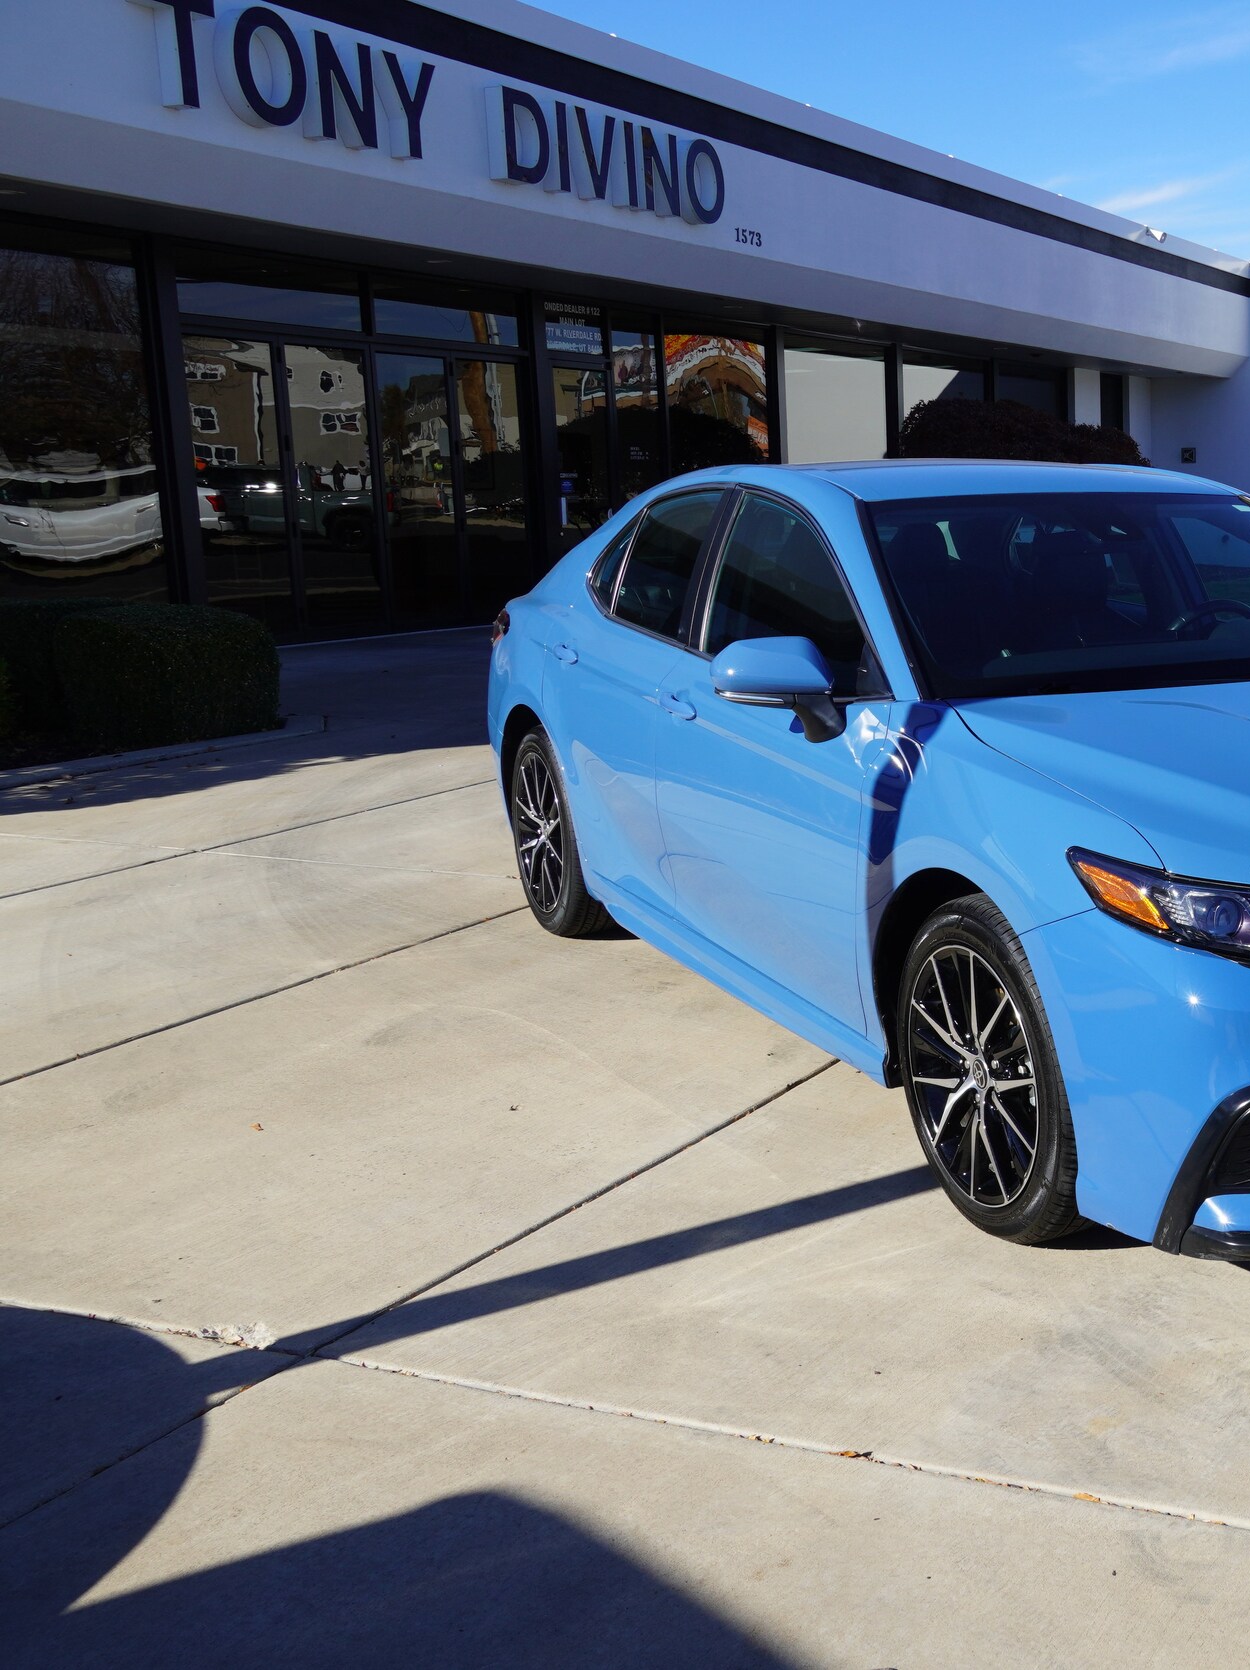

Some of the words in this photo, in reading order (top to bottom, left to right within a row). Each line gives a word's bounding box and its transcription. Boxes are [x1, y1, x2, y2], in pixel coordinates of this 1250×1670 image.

[140, 0, 435, 159] TONY
[490, 85, 725, 224] DIVINO
[734, 227, 762, 247] 1573
[544, 301, 564, 312] ONDED
[564, 304, 586, 315] DEALER
[590, 307, 601, 316] 122
[559, 316, 574, 326] MAIN
[575, 318, 586, 327] LOT
[546, 327, 554, 337] 77
[563, 329, 593, 341] RIVERDALE
